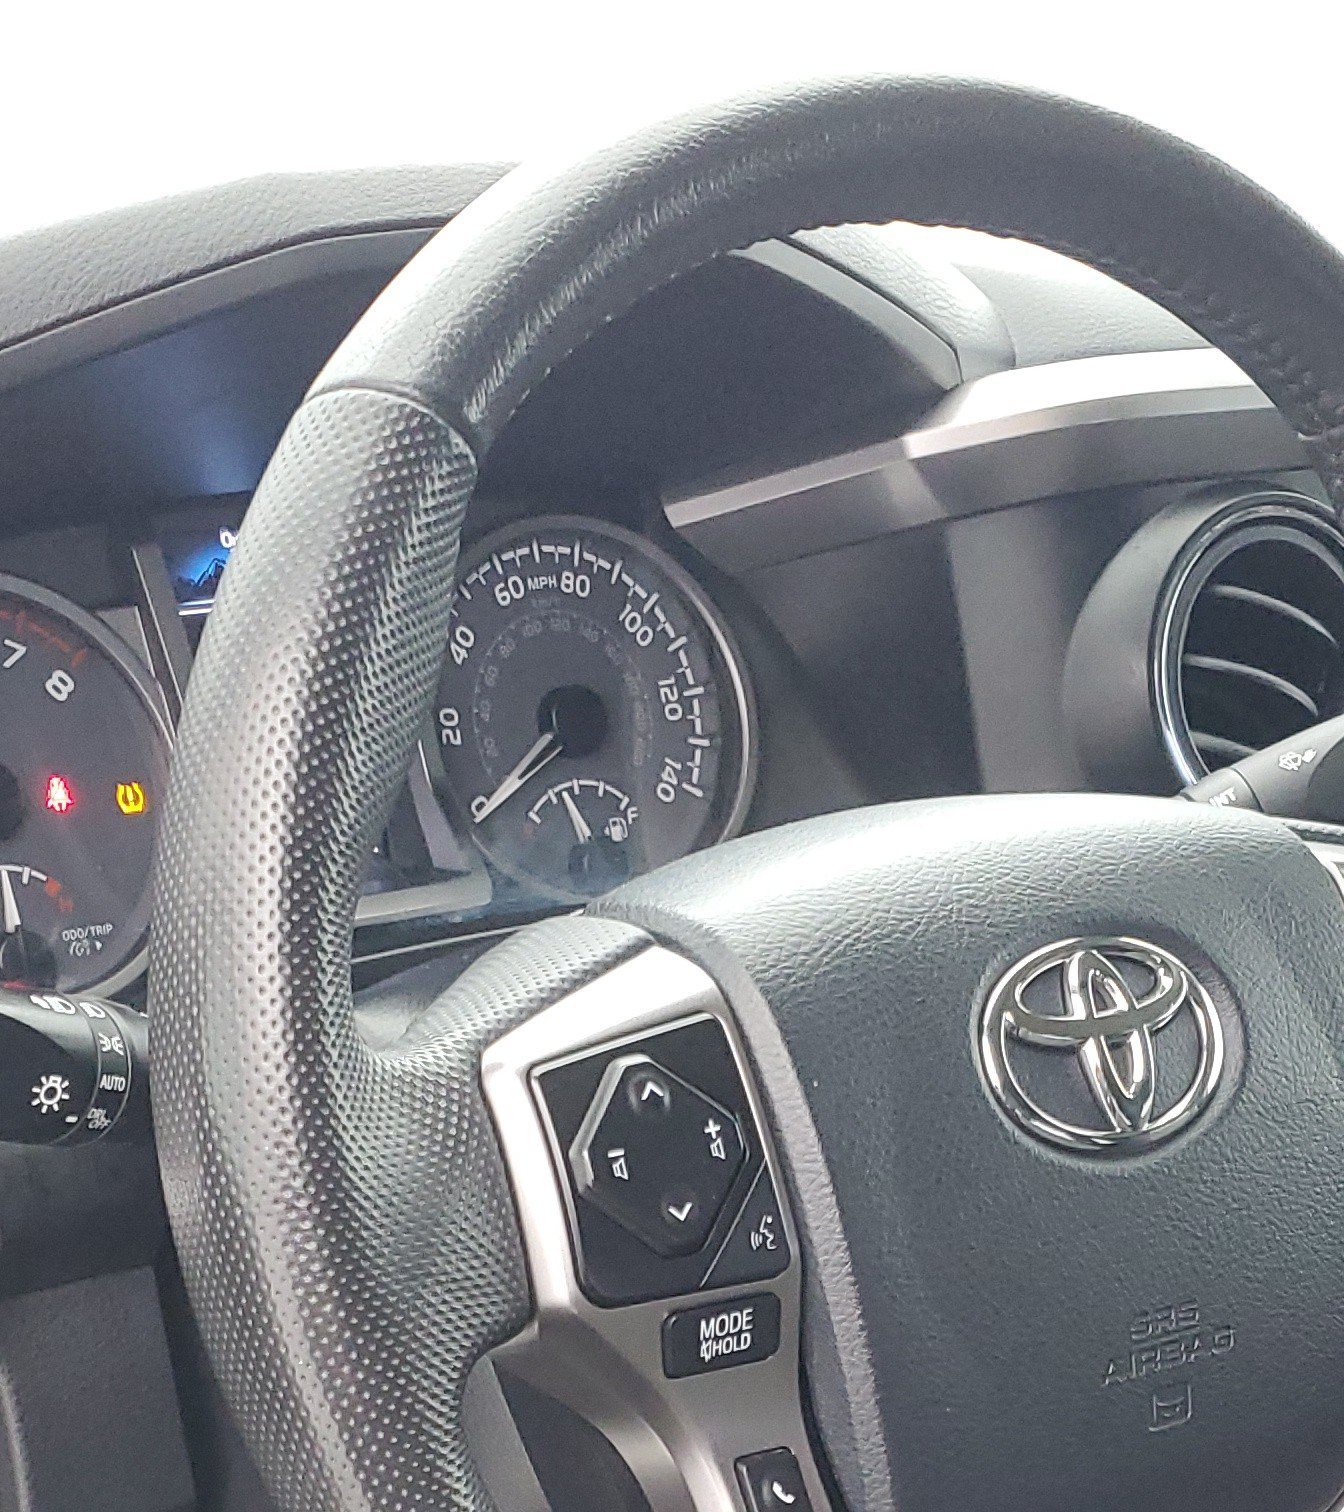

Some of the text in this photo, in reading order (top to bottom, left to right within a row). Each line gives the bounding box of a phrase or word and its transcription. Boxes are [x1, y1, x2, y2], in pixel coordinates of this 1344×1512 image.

[494, 574, 526, 607] 60
[527, 574, 557, 592] MPH
[559, 571, 591, 598] 80
[618, 603, 654, 647] 100
[2, 638, 27, 670] 7
[449, 624, 476, 666] 40
[44, 669, 76, 703] 8
[657, 676, 683, 722] 120
[438, 706, 463, 747] 20
[655, 756, 683, 803] 140
[99, 1075, 127, 1093] AUTO
[699, 1308, 754, 1341] MODE
[712, 1332, 752, 1357] HOLD
